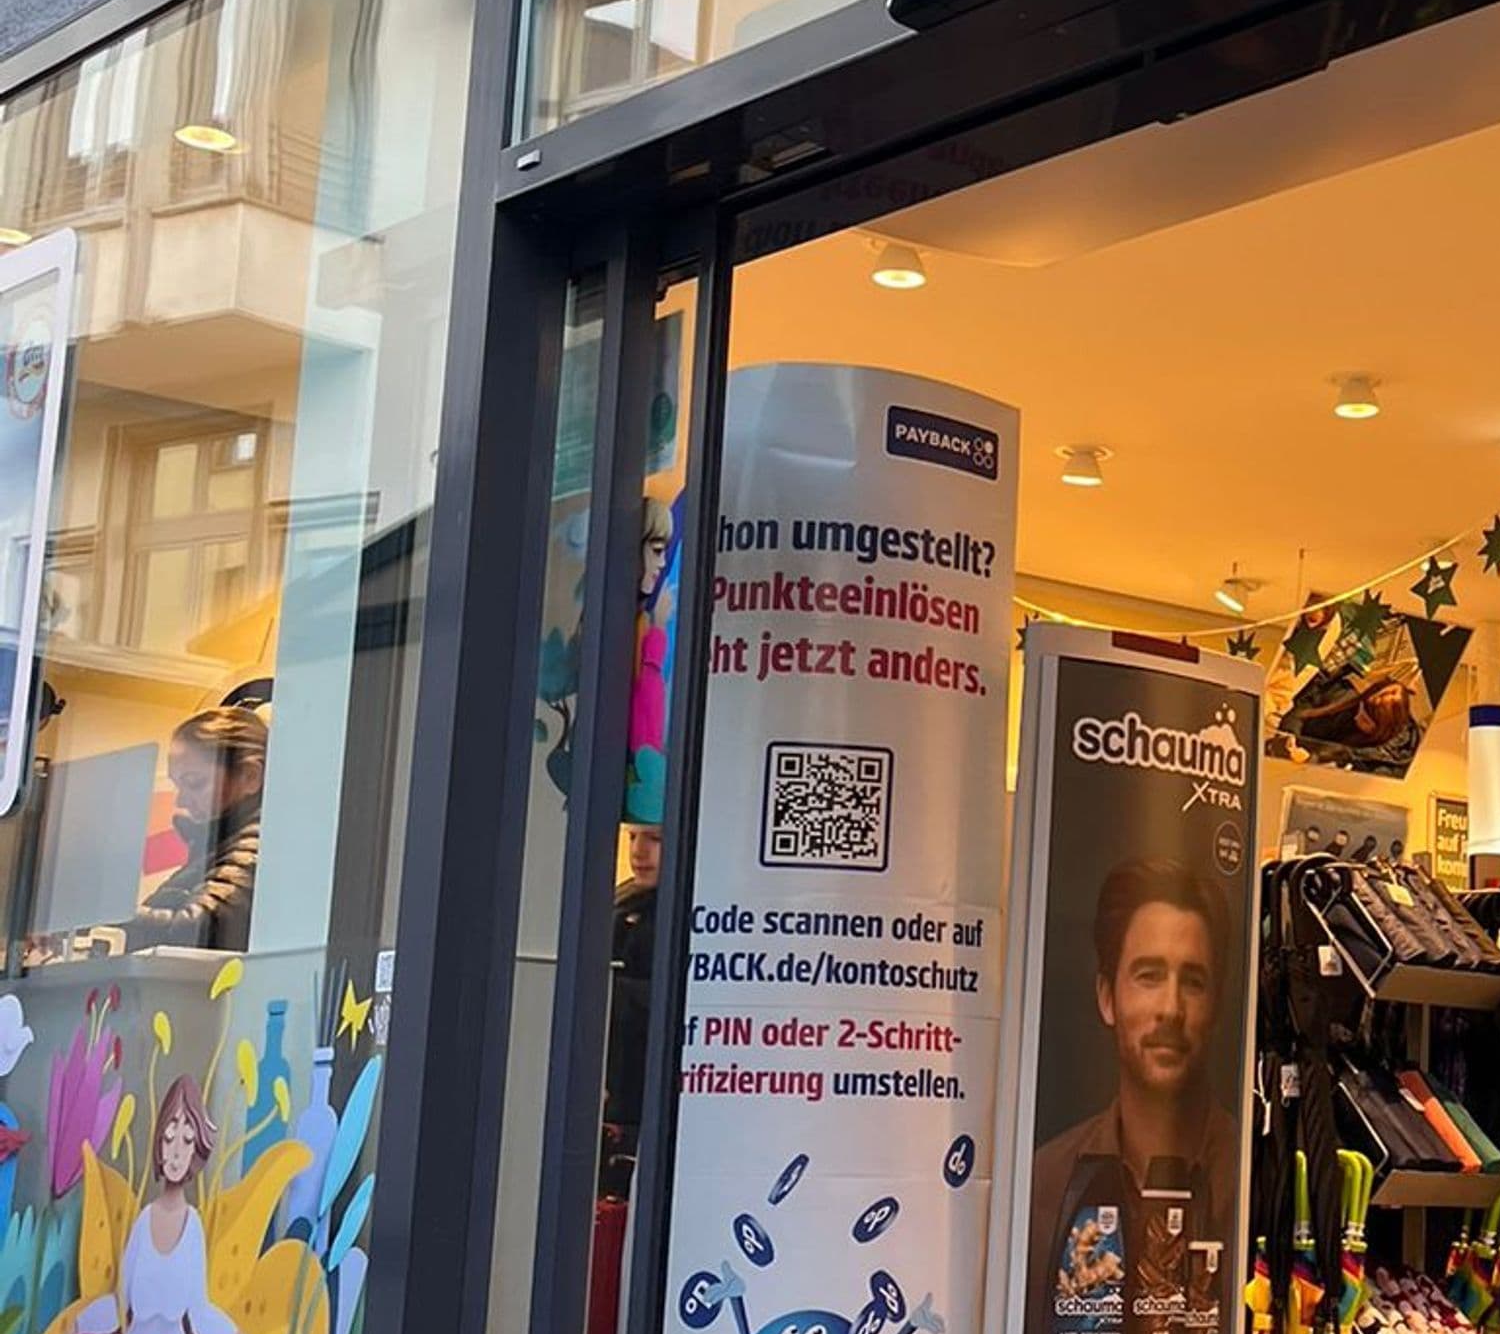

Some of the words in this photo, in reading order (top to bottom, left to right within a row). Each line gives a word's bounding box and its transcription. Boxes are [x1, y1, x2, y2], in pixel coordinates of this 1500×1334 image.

[896, 424, 970, 454] PAYBACK
[793, 520, 996, 578] umgestellt?
[757, 632, 855, 680] jetzt
[868, 646, 987, 698] anders.
[1075, 713, 1244, 785] schauma
[692, 905, 754, 934] Code
[763, 910, 882, 938] scannen
[892, 913, 947, 944] oder
[953, 920, 983, 947] auf
[704, 1017, 752, 1046] PIN
[762, 1018, 829, 1047] oder
[838, 1019, 962, 1053] 2-Schritt-
[833, 1068, 965, 1100] umstellen.
